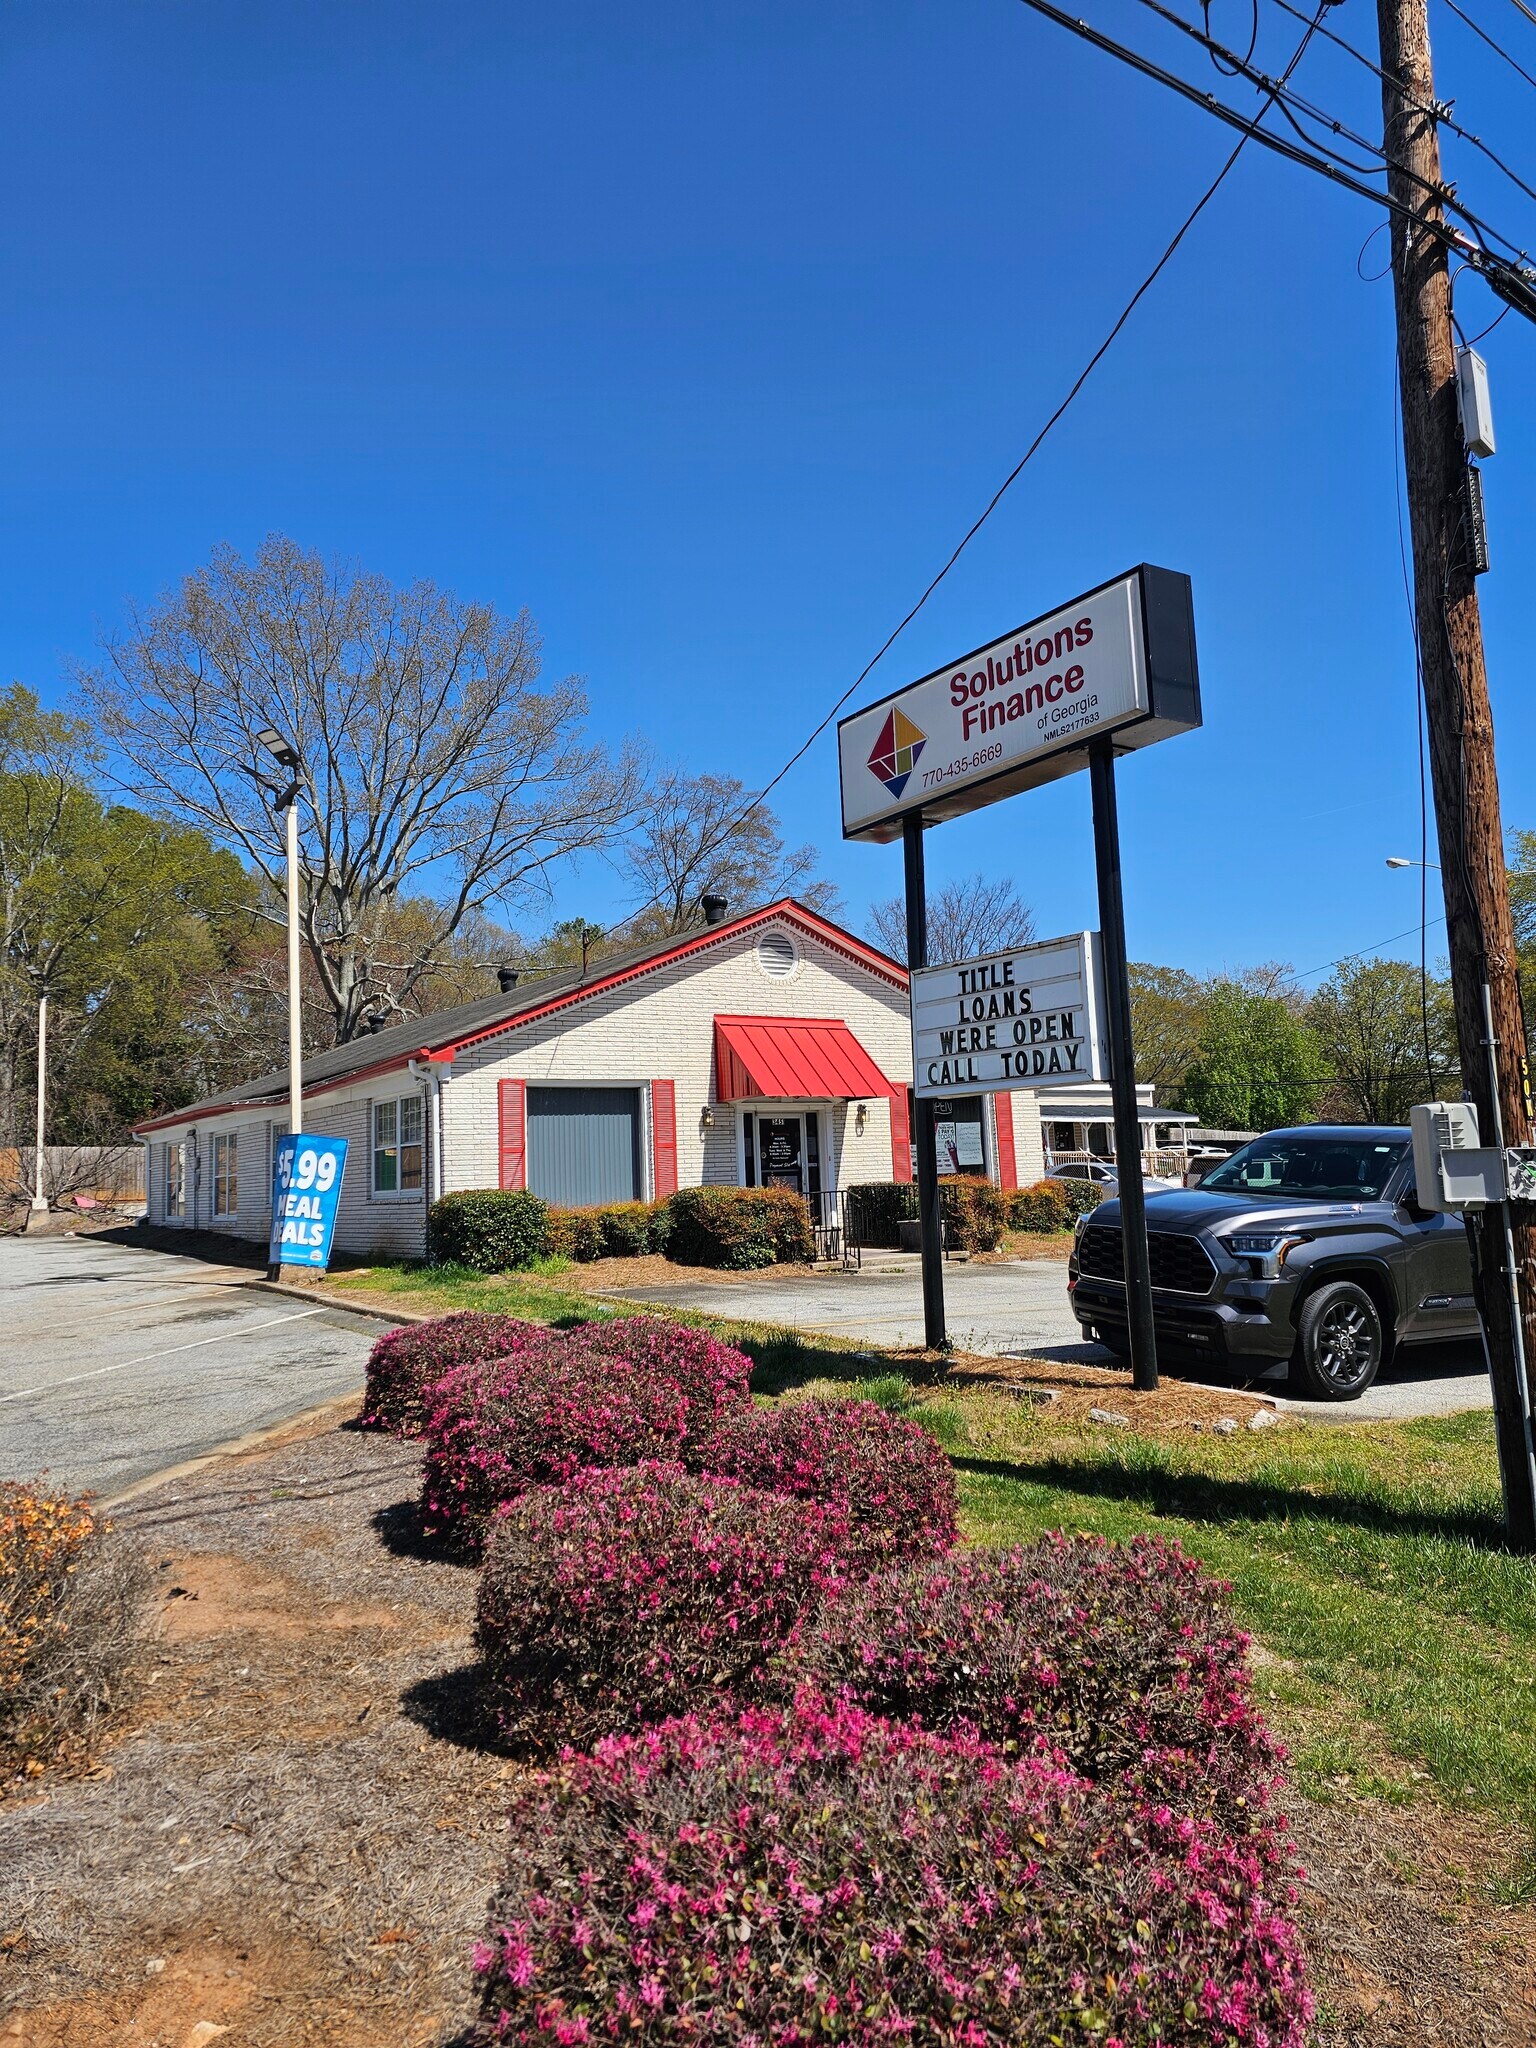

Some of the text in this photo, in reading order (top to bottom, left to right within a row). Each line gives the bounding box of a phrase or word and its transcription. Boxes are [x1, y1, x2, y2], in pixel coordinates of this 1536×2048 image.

[950, 617, 1094, 707] Solutions
[962, 664, 1085, 742] Finance
[1037, 694, 1098, 729] of Georgia
[1043, 711, 1100, 742] NMLS2177633
[922, 742, 1002, 788] 770-435-6669
[958, 960, 1015, 995] TITLE
[959, 988, 1032, 1023] LOANS
[940, 1012, 1074, 1055] WERE OPEN
[927, 1044, 1079, 1086] CALL TODAY
[933, 1101, 952, 1113] PEN
[277, 1194, 323, 1220] MEAL
[272, 1221, 325, 1247] DEALS
